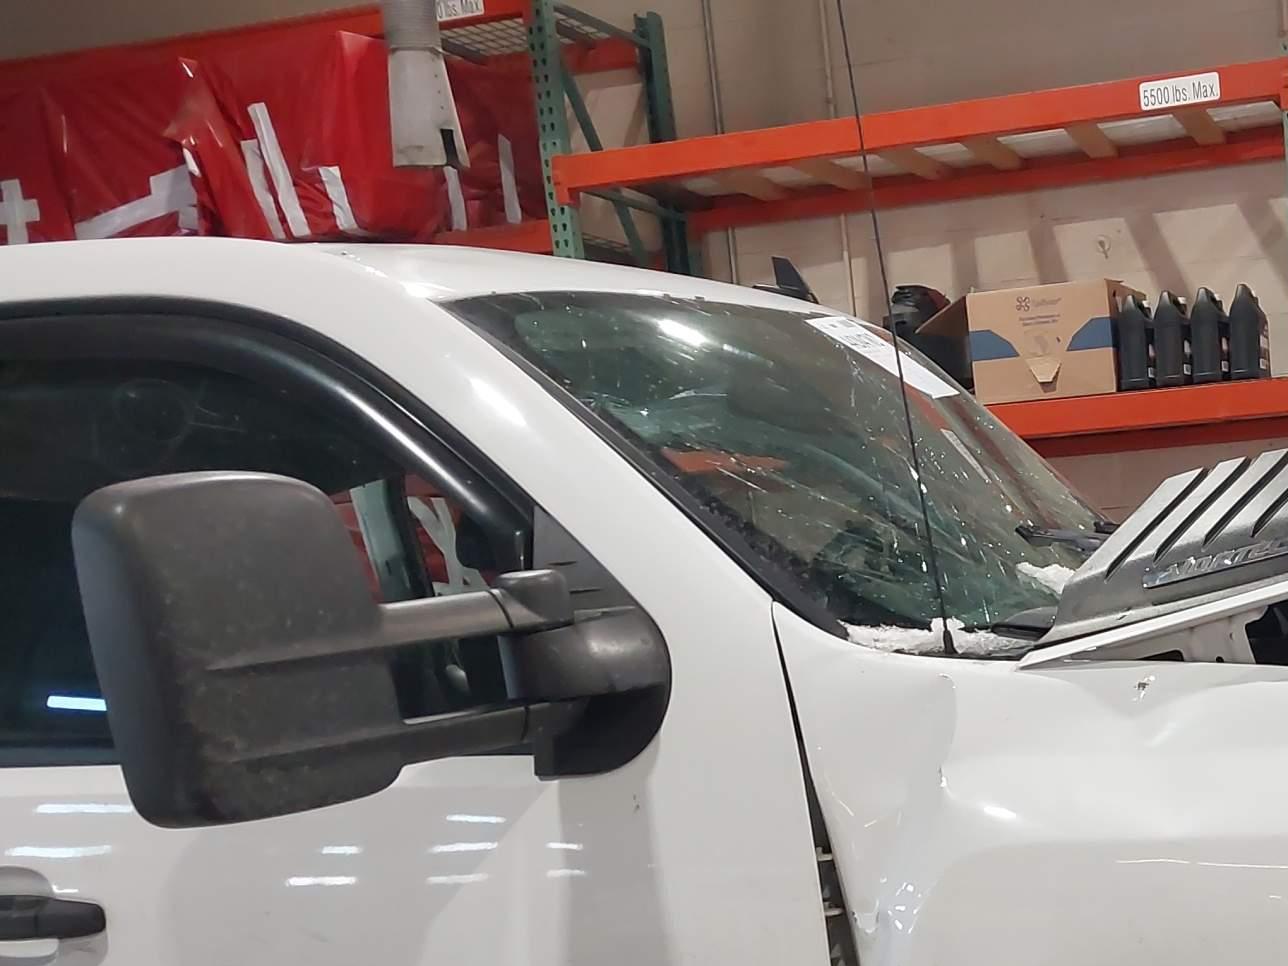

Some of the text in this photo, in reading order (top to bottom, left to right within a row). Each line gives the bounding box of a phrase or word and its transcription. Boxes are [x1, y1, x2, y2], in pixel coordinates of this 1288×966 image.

[1143, 80, 1218, 107] 5500 lbs. Max.
